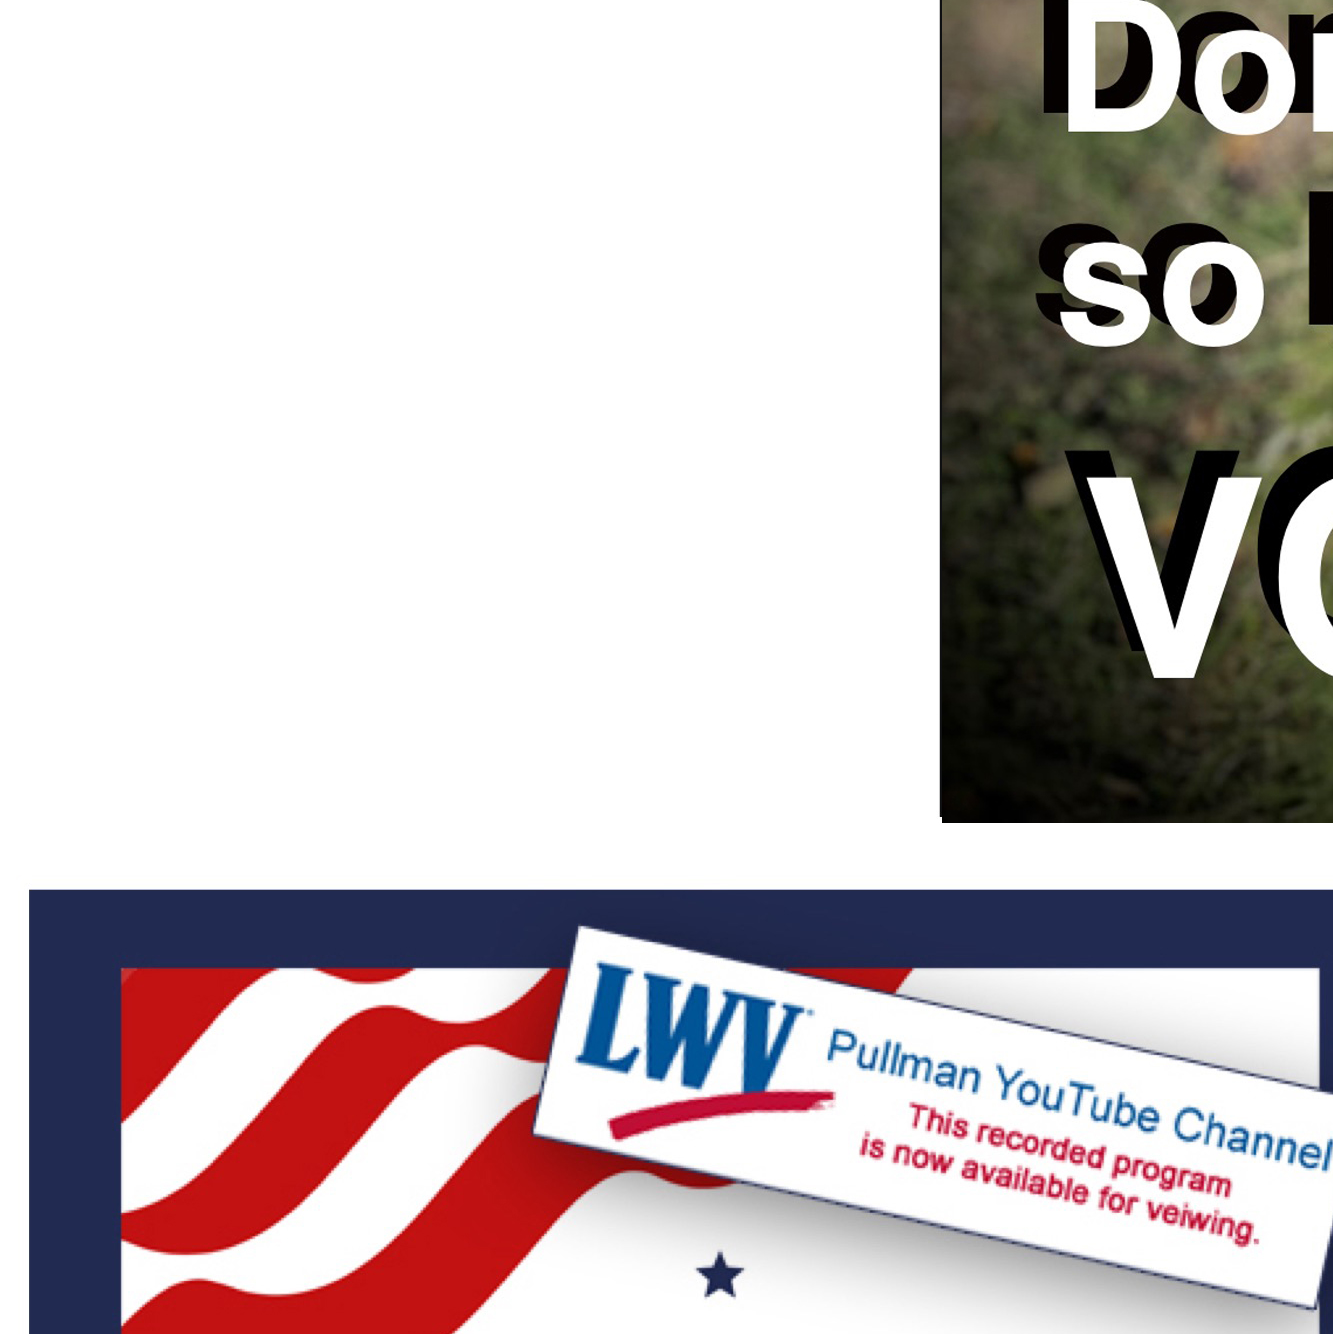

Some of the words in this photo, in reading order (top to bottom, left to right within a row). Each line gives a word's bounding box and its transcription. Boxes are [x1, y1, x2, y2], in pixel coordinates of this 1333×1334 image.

[576, 963, 804, 1091] LWV
[828, 1029, 980, 1093] Pullman
[997, 1065, 1160, 1131] YouTube
[1174, 1107, 1333, 1171] Channel
[909, 1103, 969, 1140] This
[977, 1125, 1107, 1170] recorded
[1112, 1155, 1232, 1199] program
[859, 1132, 885, 1160] is
[892, 1145, 955, 1174] now
[961, 1159, 1090, 1206] available
[1098, 1186, 1140, 1216] for
[1146, 1201, 1261, 1247] veiwing.
